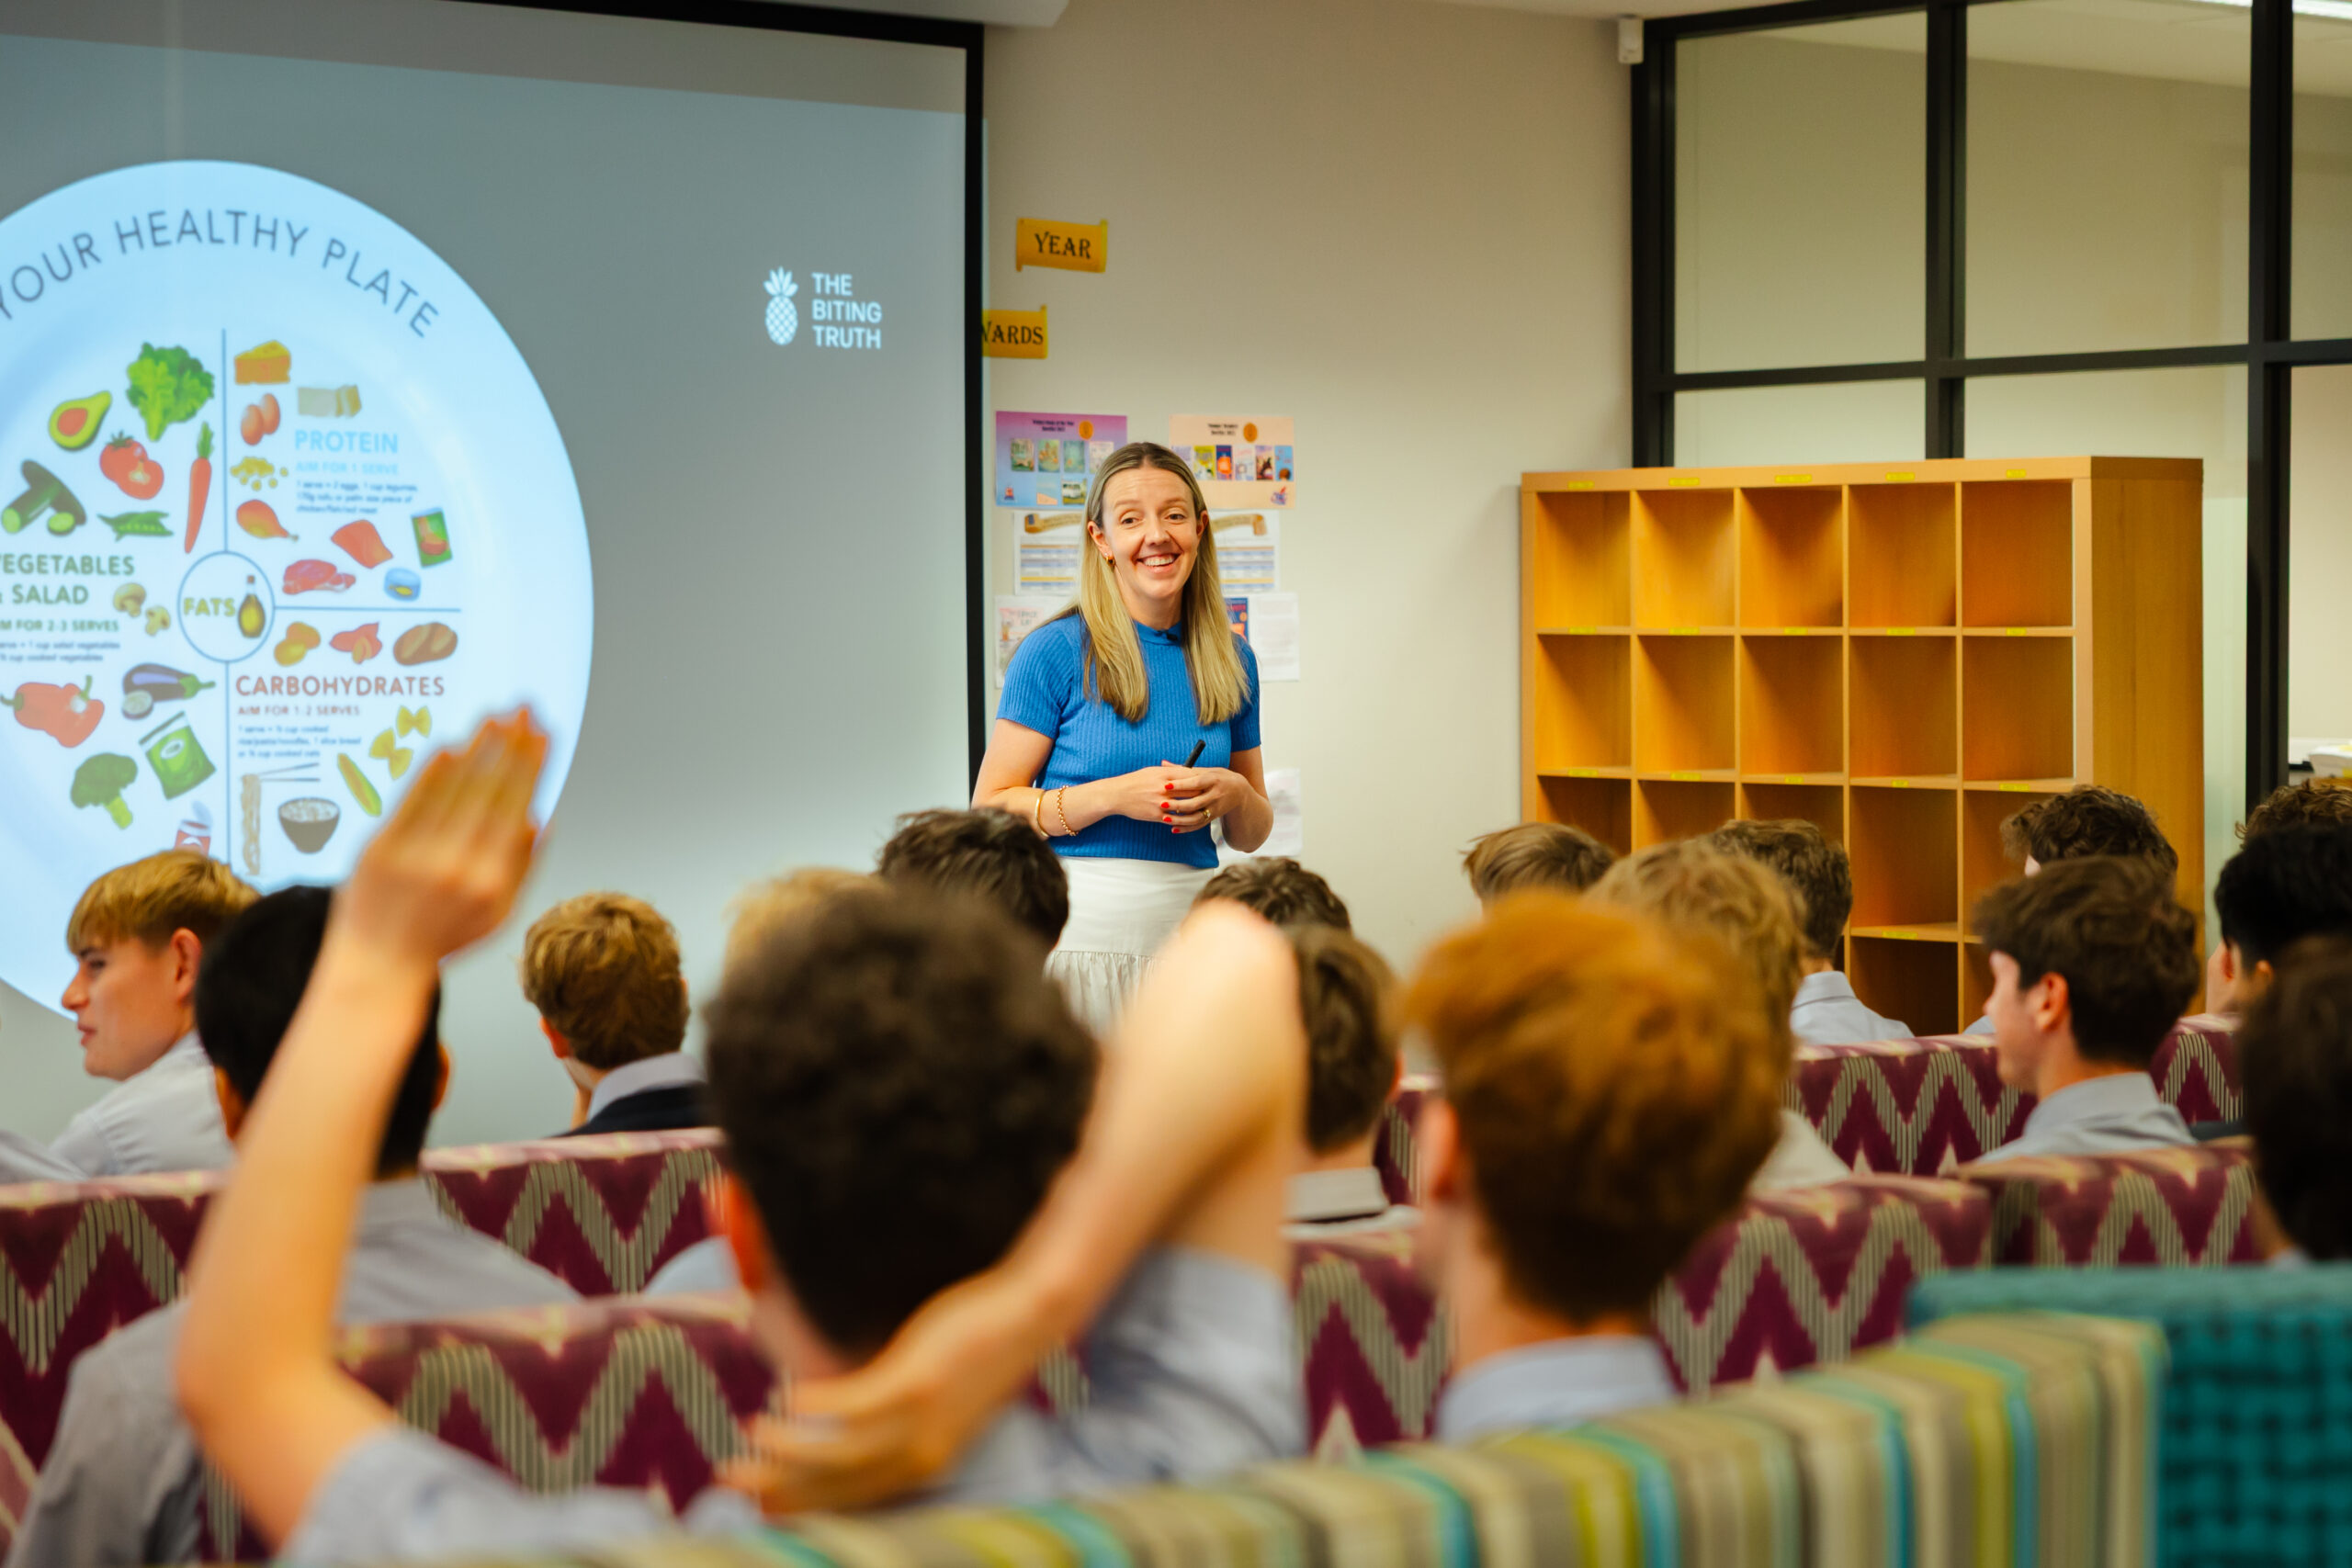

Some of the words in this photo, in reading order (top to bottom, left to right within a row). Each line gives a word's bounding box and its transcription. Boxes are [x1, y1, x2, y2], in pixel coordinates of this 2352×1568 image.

[1035, 231, 1091, 259] YEAR
[114, 209, 309, 257] HEALTHY
[322, 238, 439, 338] PLATE
[811, 272, 853, 296] THE
[812, 299, 882, 323] BITING
[812, 325, 881, 349] TRUTH
[295, 429, 398, 454] PROTEIN
[296, 462, 319, 471] AIM
[322, 462, 347, 473] FOR
[362, 463, 399, 475] SERVE
[0, 553, 134, 576] EGETABLES
[12, 583, 89, 604] SALAD
[185, 597, 235, 617] FATS
[17, 619, 42, 631] FOR
[73, 620, 119, 632] SERVES
[236, 676, 445, 696] CARBOHYDRATES
[238, 705, 261, 716] AIM
[265, 705, 289, 716] FOR
[317, 705, 361, 716] SERVES
